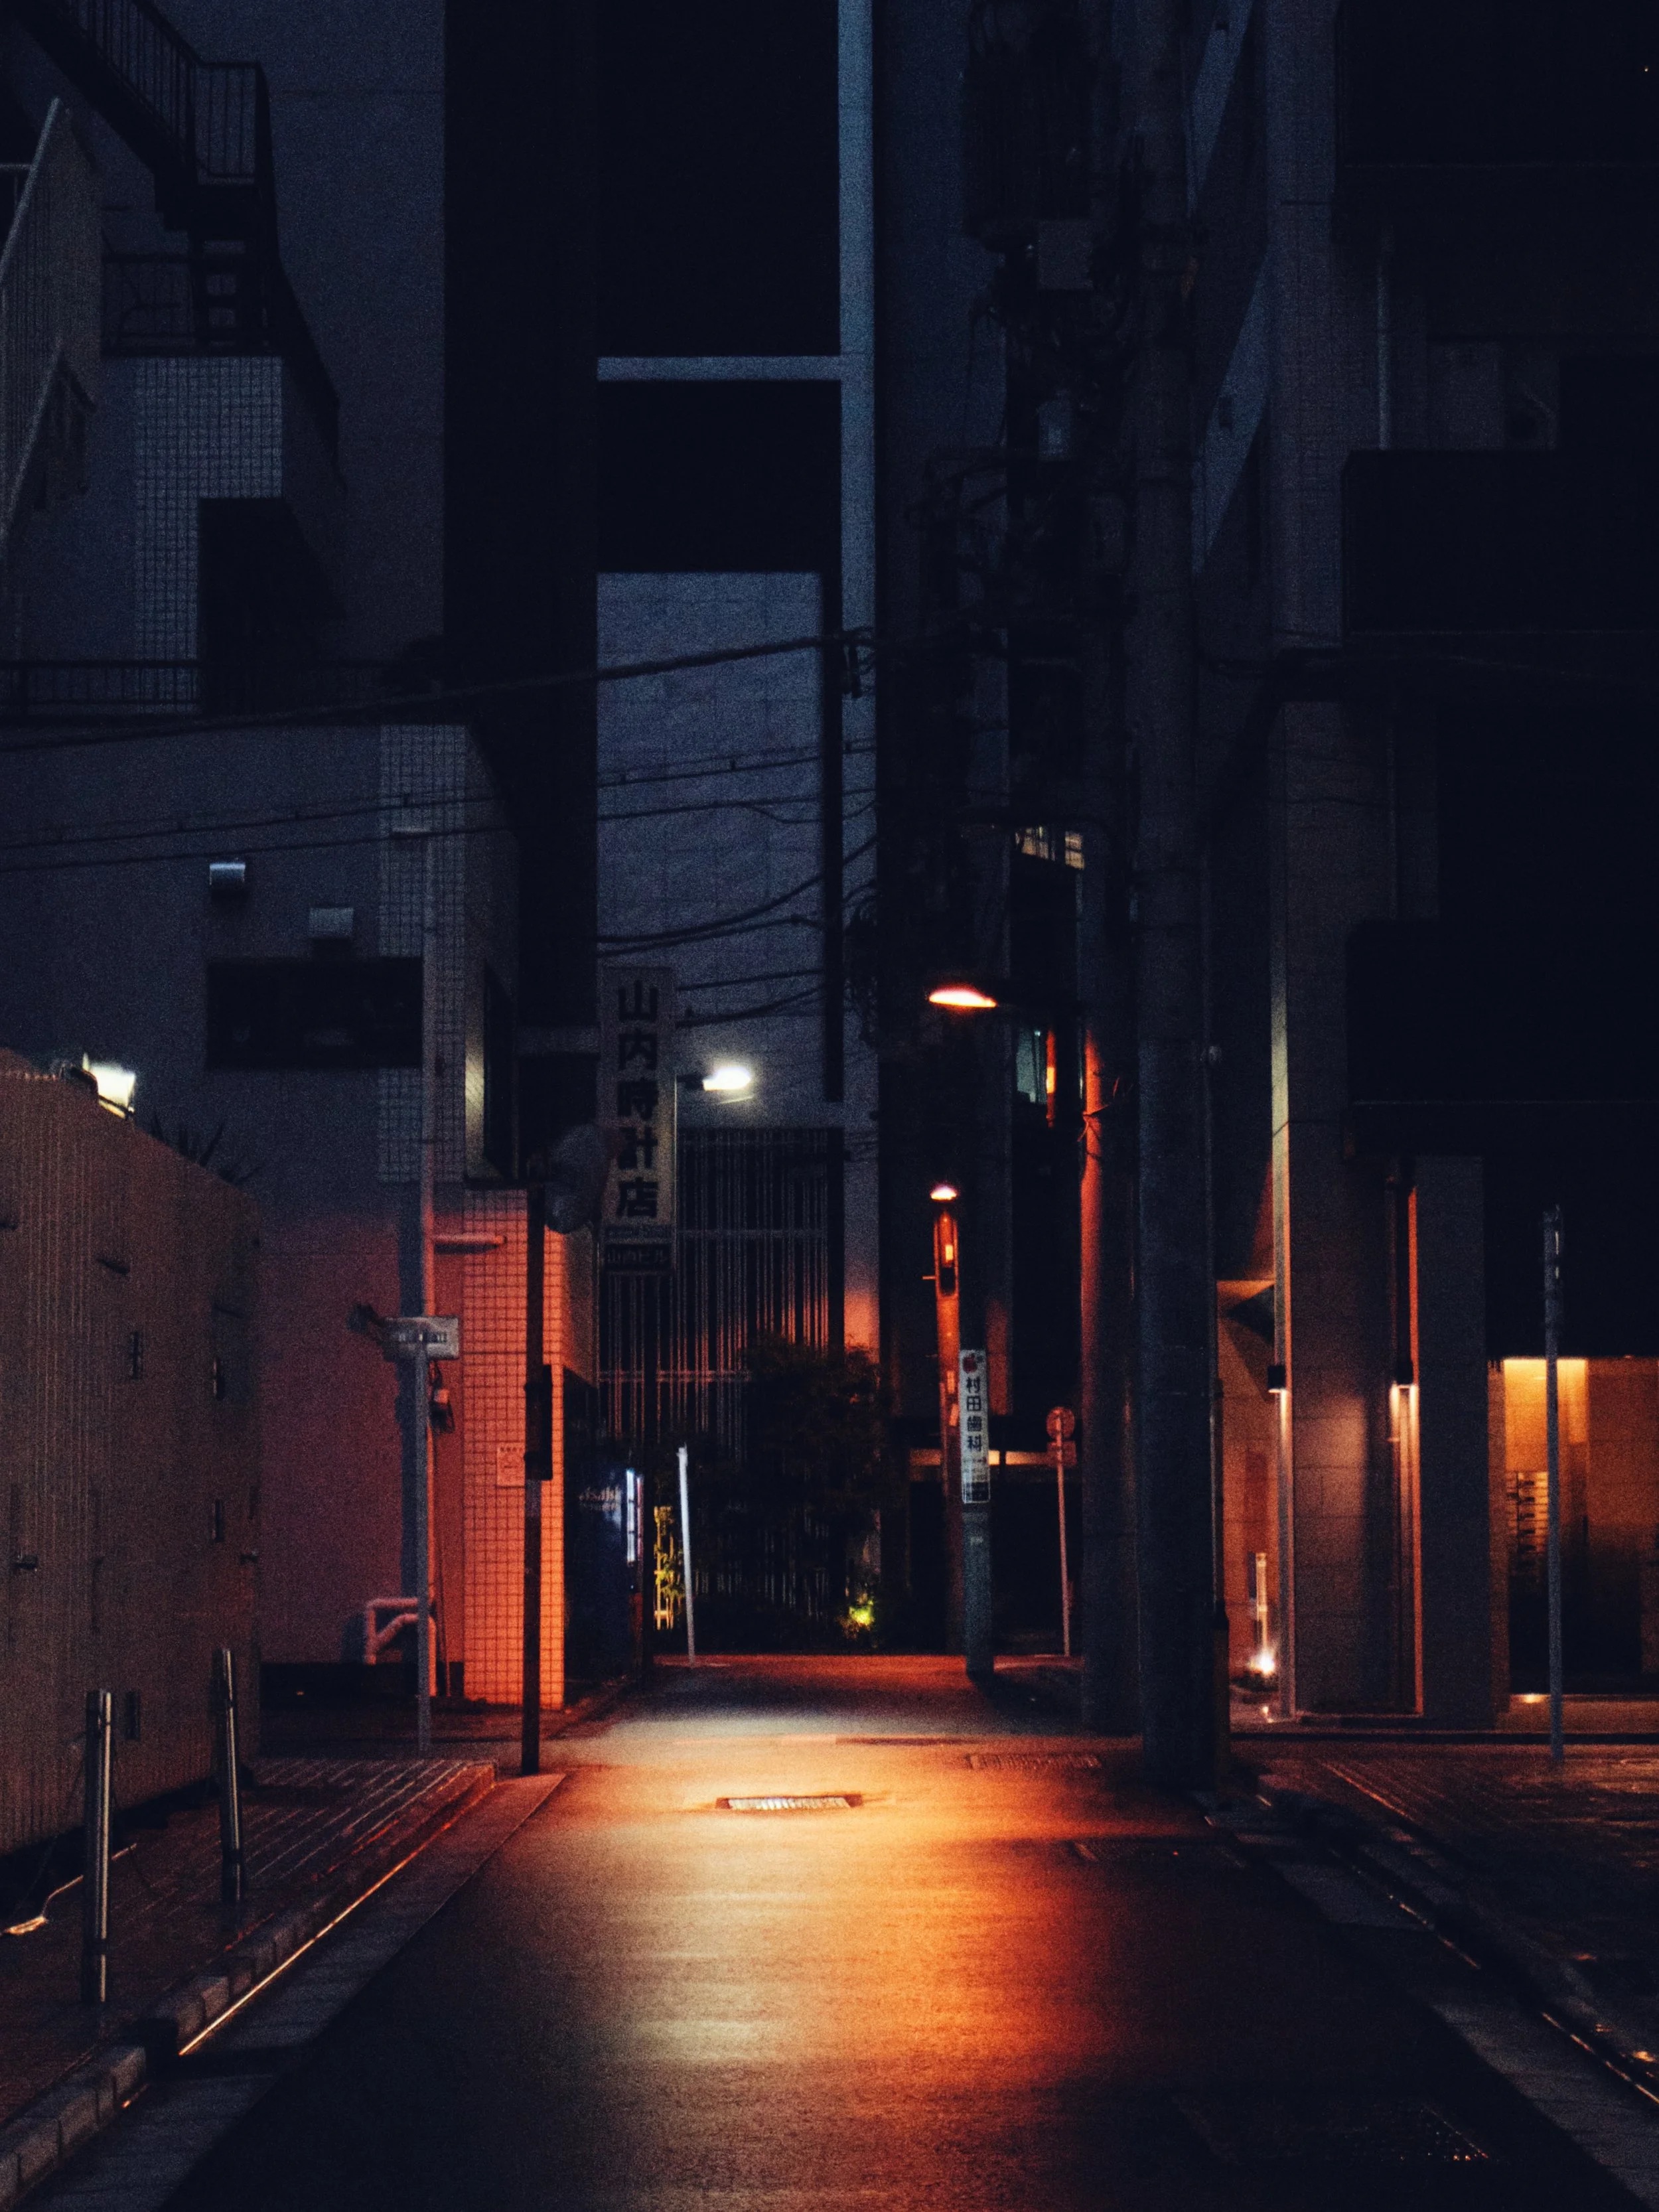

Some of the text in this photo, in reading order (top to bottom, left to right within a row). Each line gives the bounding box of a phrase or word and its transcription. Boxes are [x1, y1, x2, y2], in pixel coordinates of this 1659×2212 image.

[617, 979, 659, 1218] 山内時計店
[966, 1376, 983, 1453] 村田歯科
